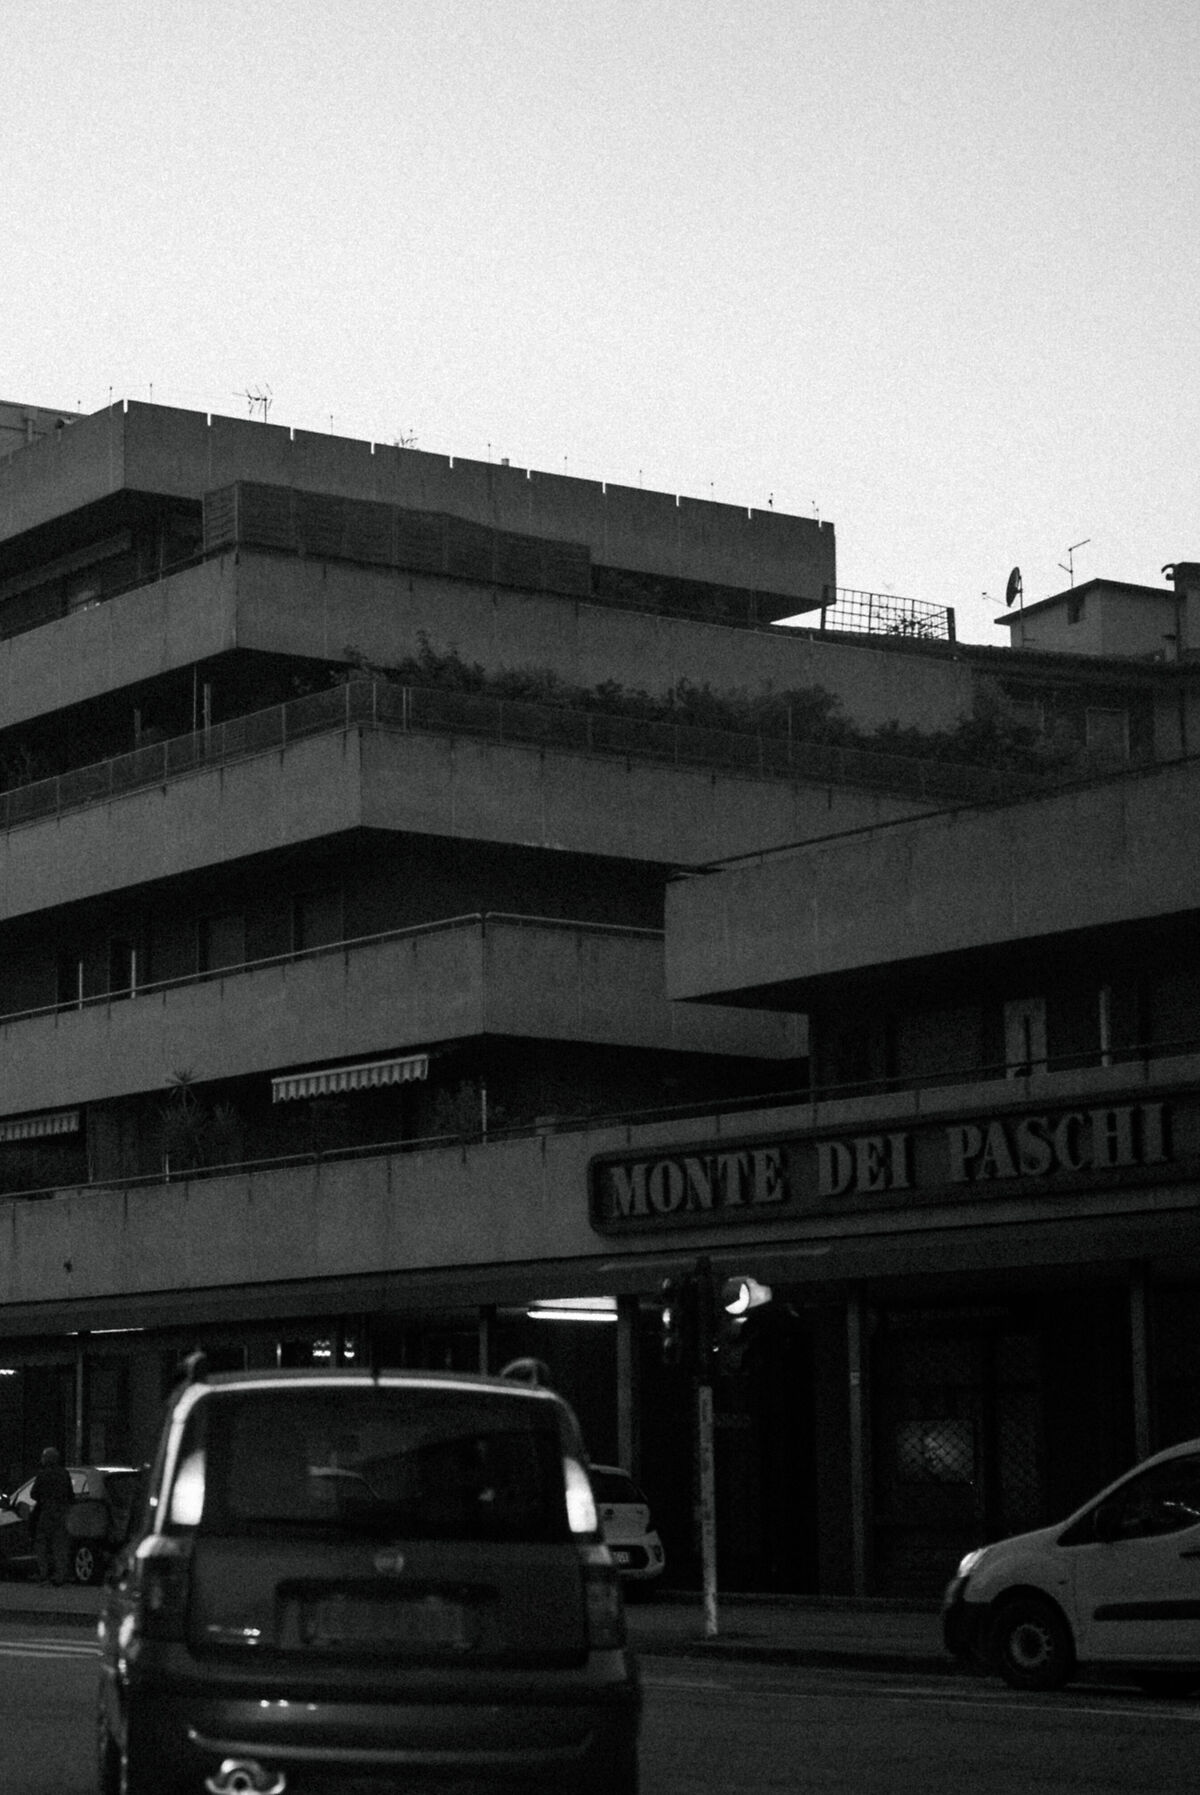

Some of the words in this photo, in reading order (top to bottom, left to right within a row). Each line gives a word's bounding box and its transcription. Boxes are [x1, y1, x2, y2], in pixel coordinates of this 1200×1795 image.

[610, 1150, 783, 1220] MONTE
[817, 1133, 912, 1198] DEI
[948, 1101, 1172, 1183] PASCHI
